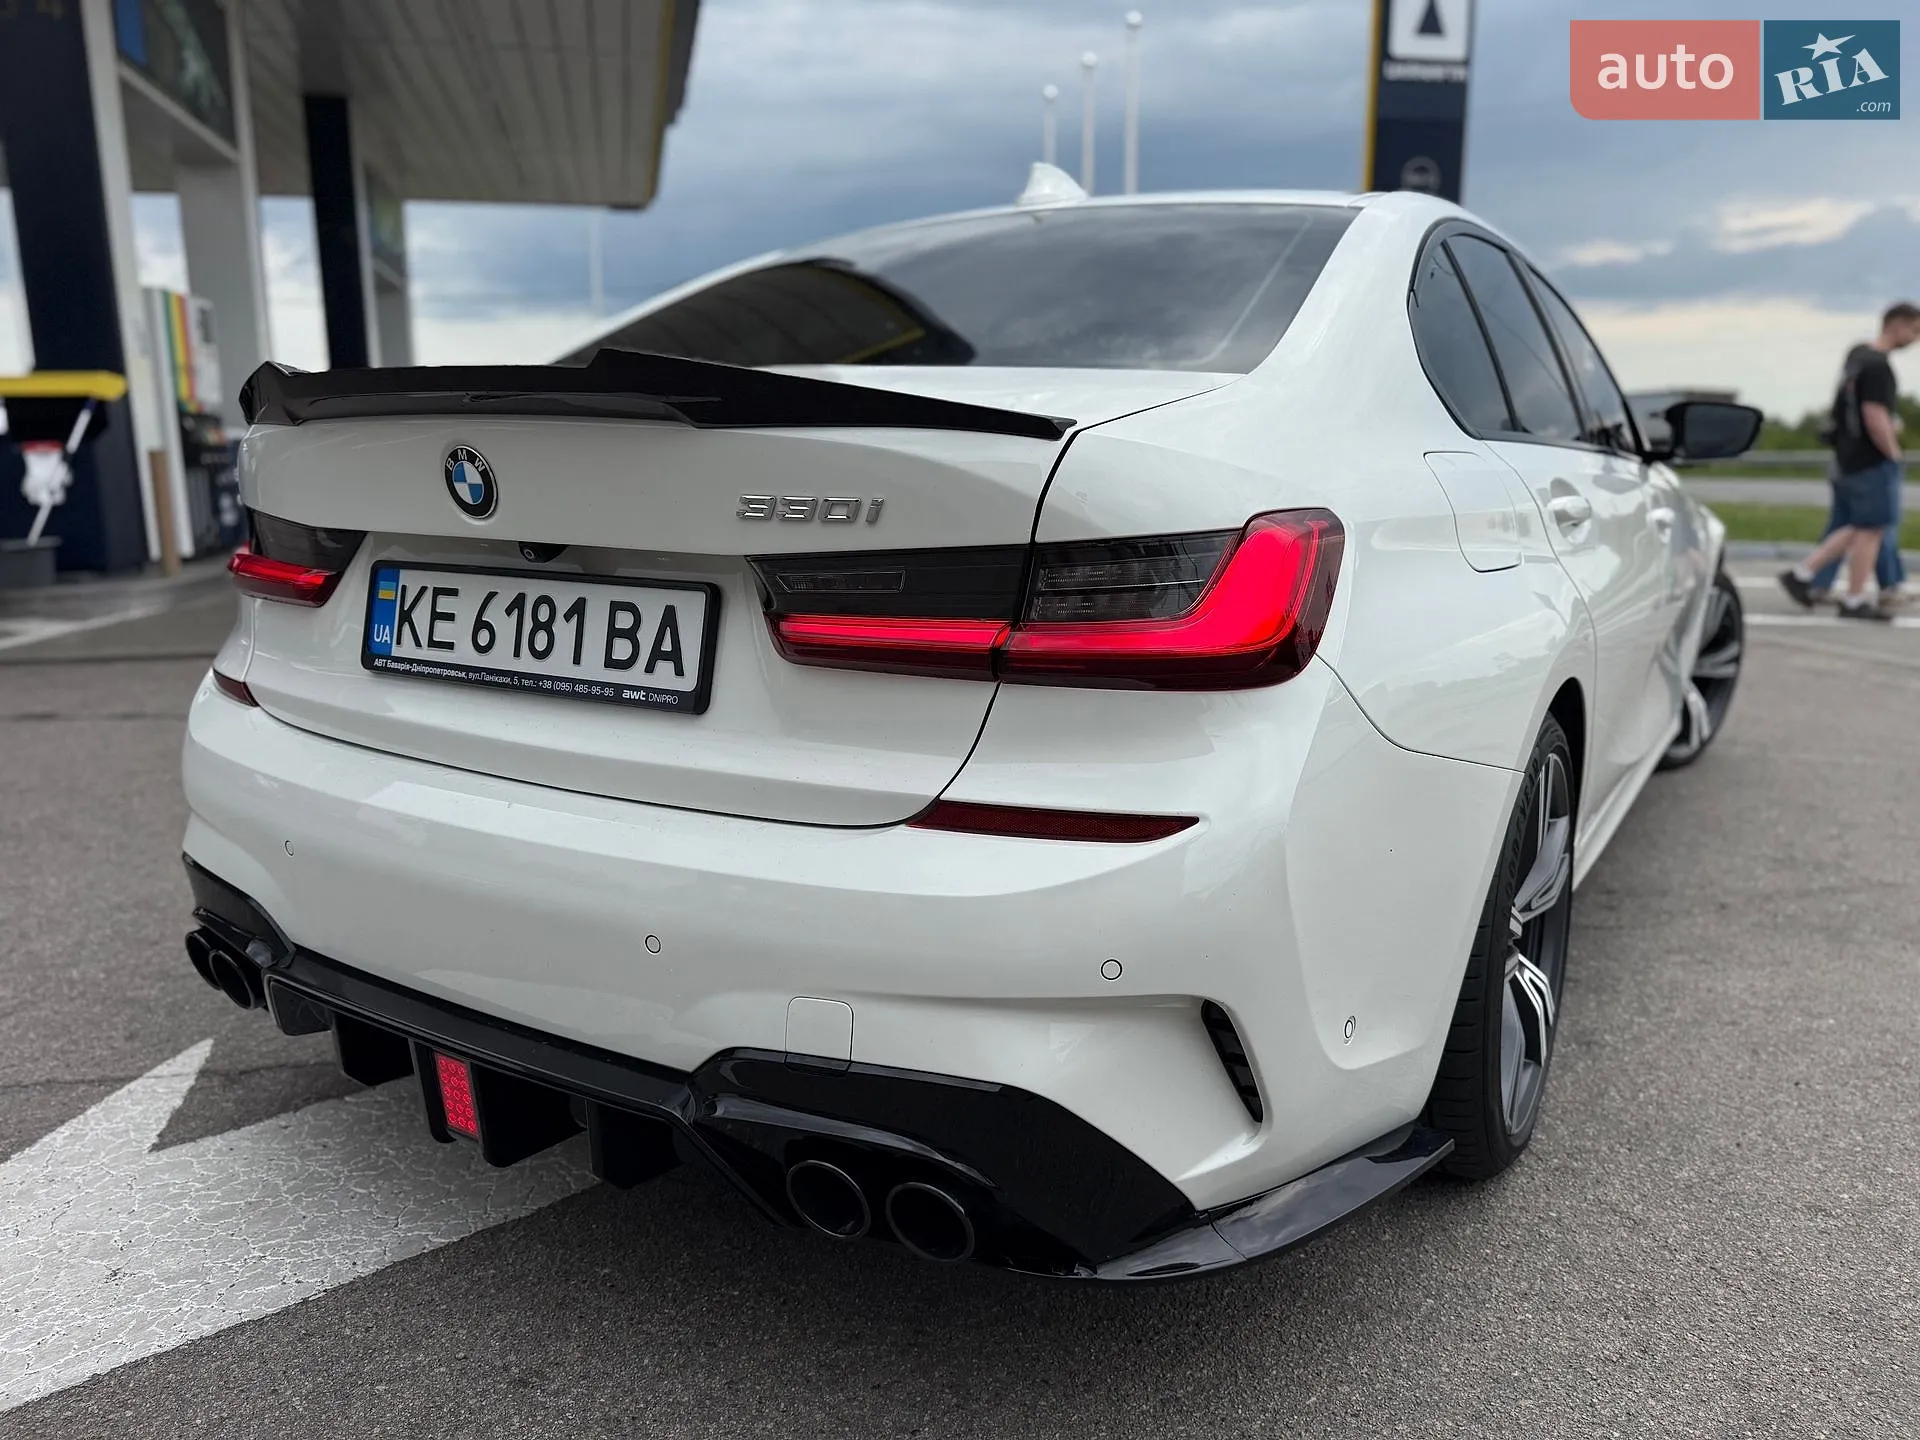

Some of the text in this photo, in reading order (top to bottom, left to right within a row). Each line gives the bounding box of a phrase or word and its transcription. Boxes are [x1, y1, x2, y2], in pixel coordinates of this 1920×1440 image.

[446, 449, 486, 471] BMW
[736, 494, 885, 524] 330i
[373, 623, 391, 644] UA
[396, 584, 685, 677] KE 6181 BA
[513, 676, 520, 686] 5,
[538, 680, 552, 689] +38
[553, 681, 573, 692] (095)
[573, 684, 615, 697] 485-95-95
[622, 689, 679, 705] awt DNIPRO
